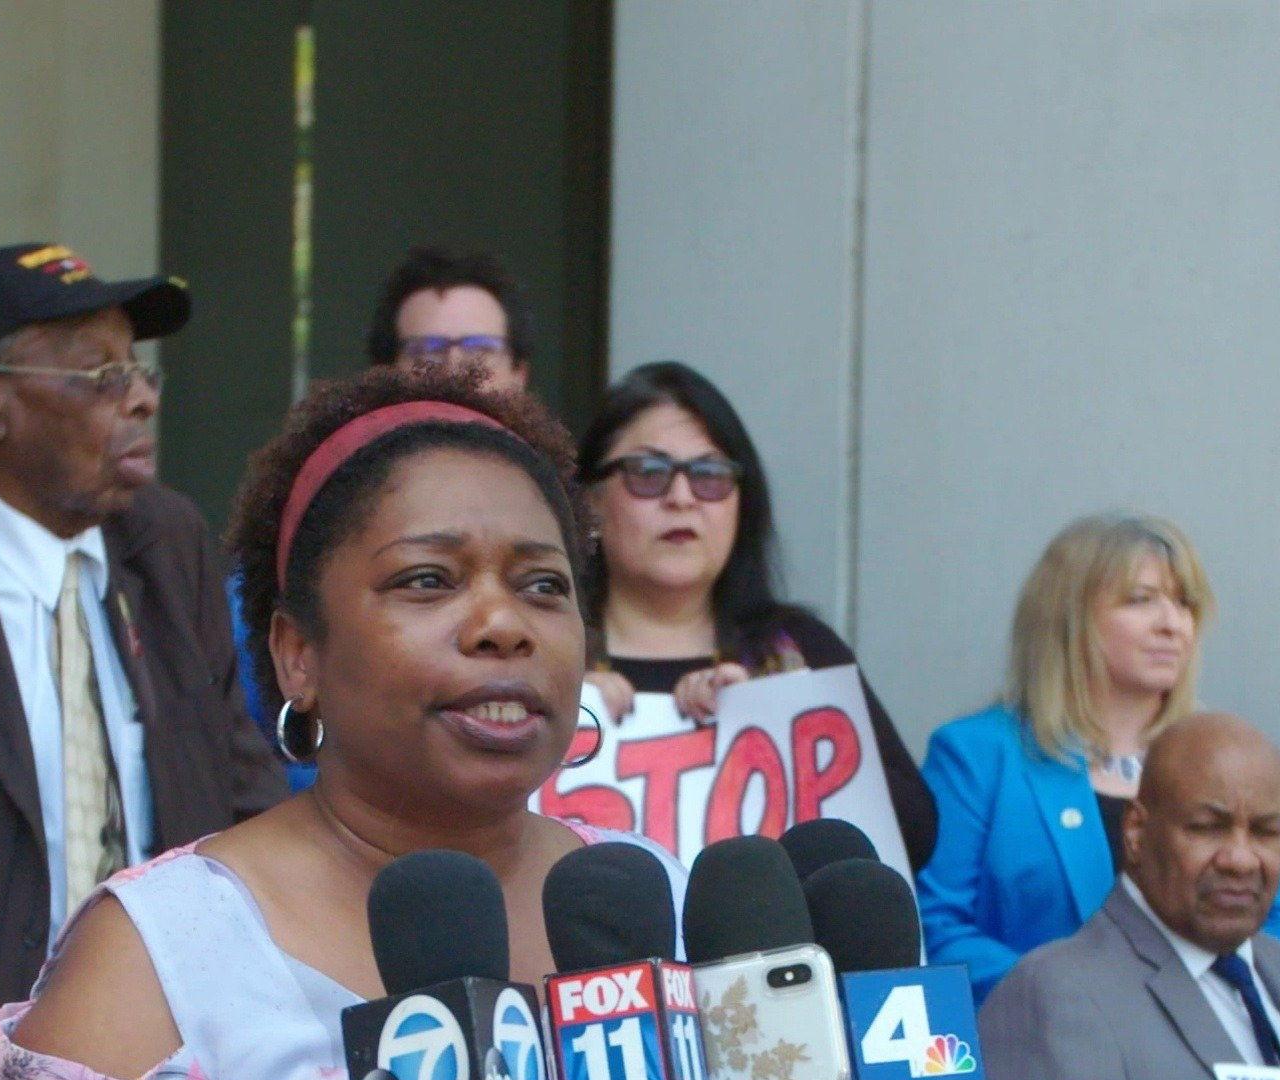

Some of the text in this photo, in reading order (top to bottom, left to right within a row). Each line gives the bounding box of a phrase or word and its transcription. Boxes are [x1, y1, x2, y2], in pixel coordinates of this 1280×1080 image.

[558, 968, 649, 1022] FOX
[663, 968, 697, 1009] FOX
[860, 984, 932, 1078] 4
